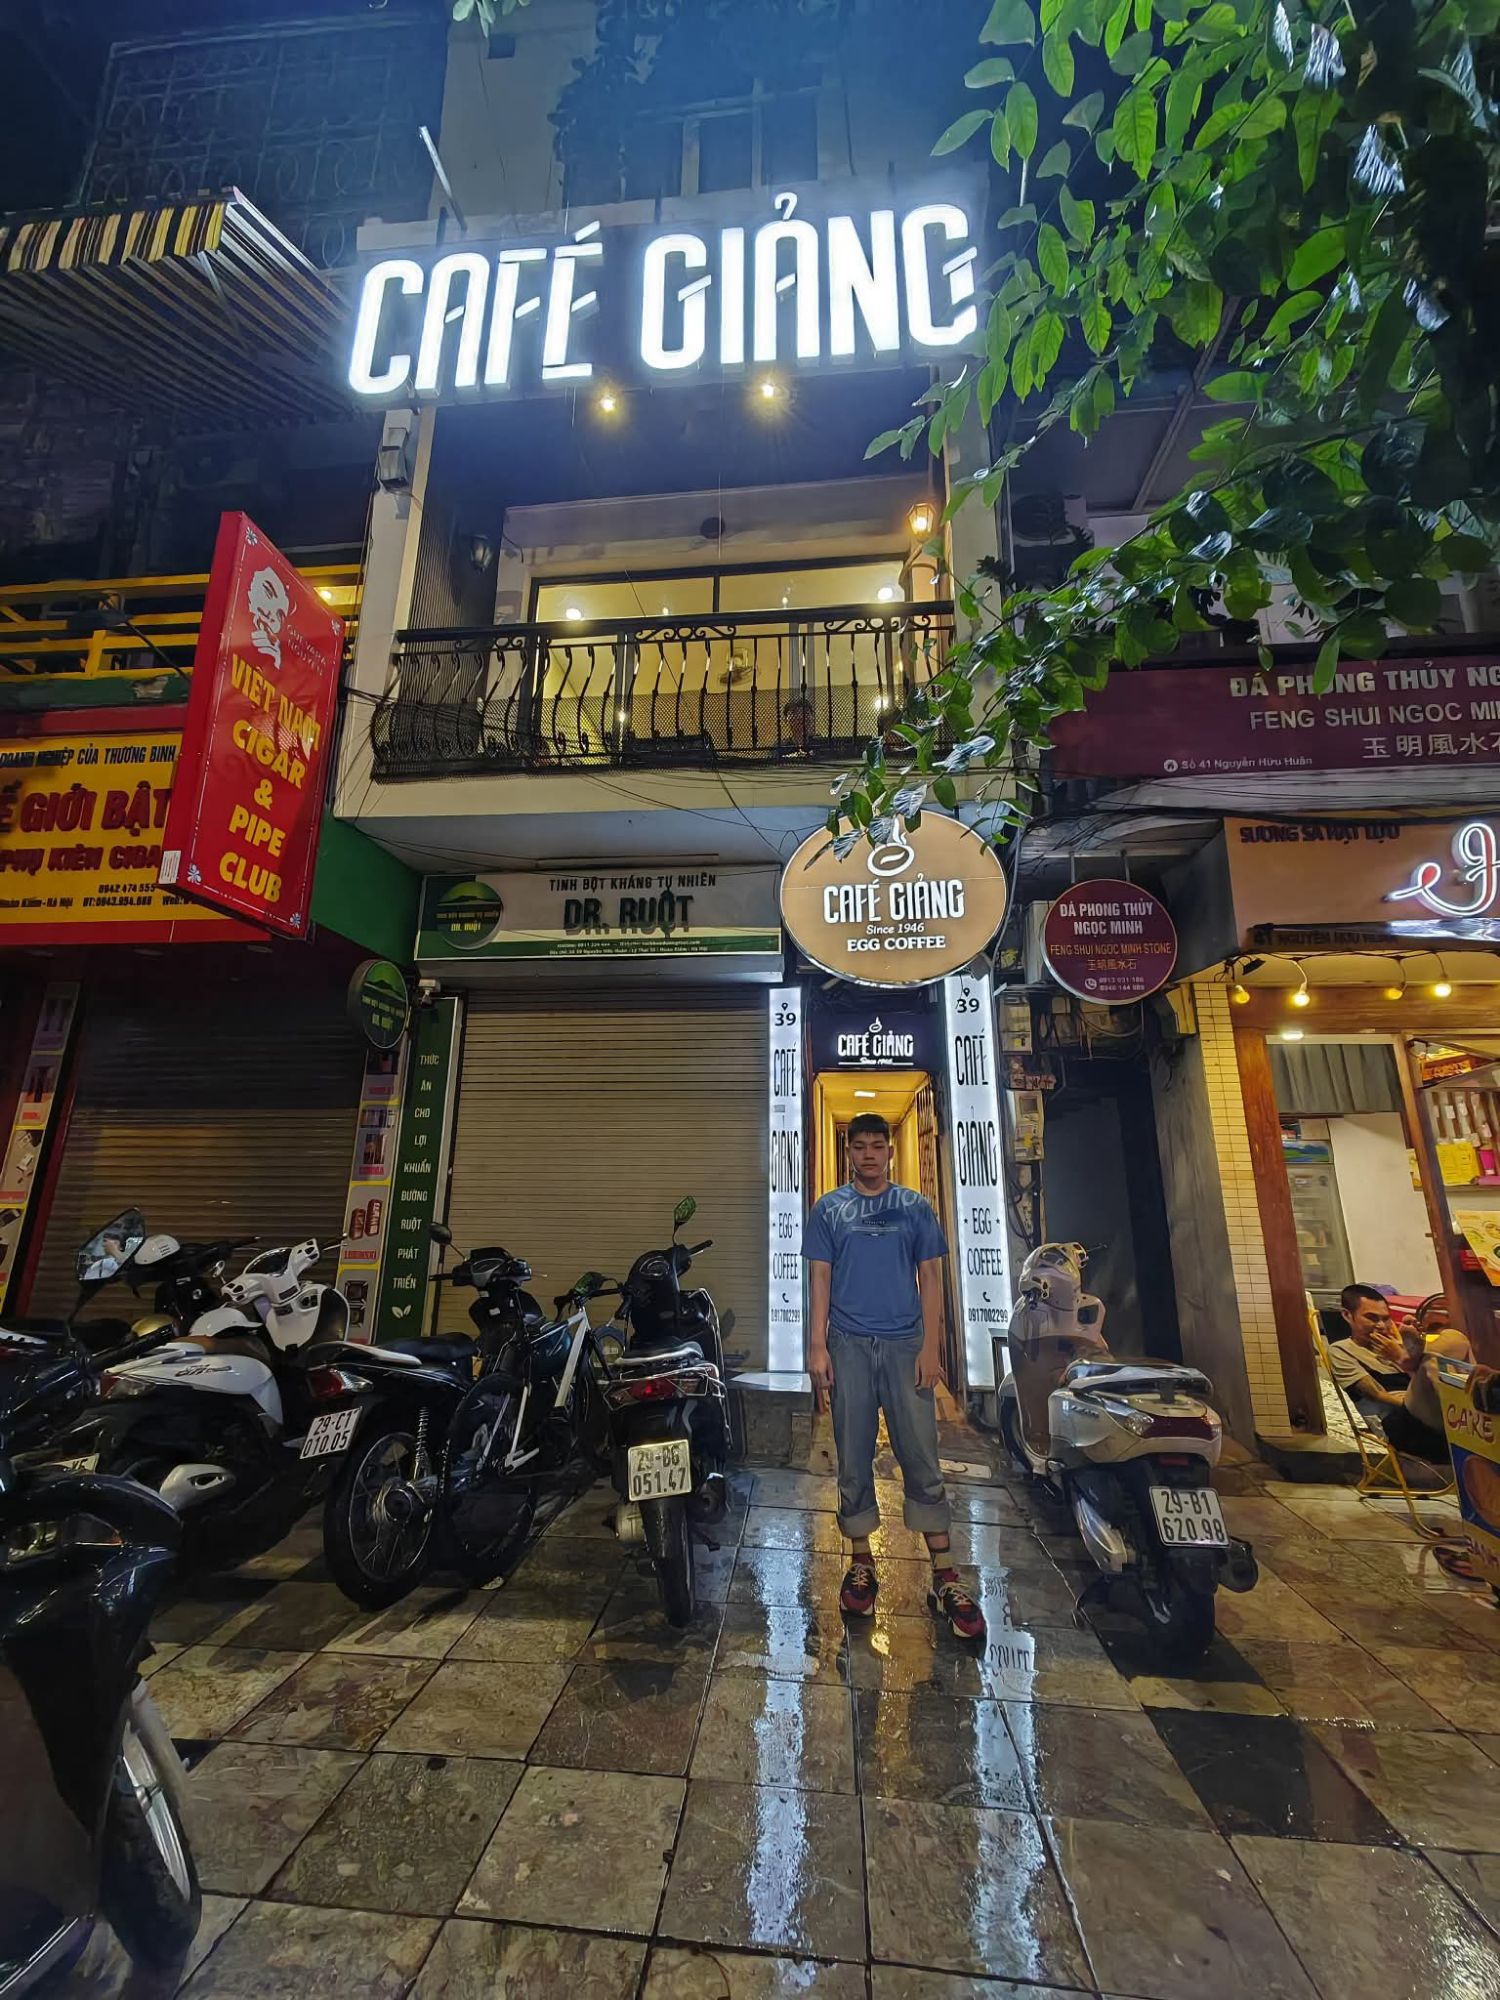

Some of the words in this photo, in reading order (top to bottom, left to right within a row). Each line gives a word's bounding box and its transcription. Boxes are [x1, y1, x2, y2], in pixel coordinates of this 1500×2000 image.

[347, 221, 603, 395] CAFÉ
[640, 192, 977, 370] GIẢNG
[1230, 672, 1269, 697] ĐÁ
[1277, 671, 1376, 697] PHNG
[1383, 661, 1456, 690] THỦY
[277, 693, 321, 751] NAM
[1250, 709, 1315, 730] FENG
[1325, 706, 1381, 727] SHUI
[1389, 703, 1463, 724] NGOC
[150, 745, 176, 763] BINH
[232, 719, 306, 789] CIGAR
[1199, 760, 1211, 769] 41
[254, 778, 273, 811] &
[228, 804, 286, 858] PIPE
[219, 851, 282, 903] CLUB
[550, 879, 577, 891] TINH
[583, 876, 605, 893] BỘT
[610, 875, 652, 890] KHÁNG
[678, 872, 716, 887] NHIÊN
[823, 879, 881, 923] CAFÉ
[889, 873, 965, 921] GIẢNG
[1079, 902, 1120, 917] PHONG
[1123, 897, 1153, 916] THỦY
[564, 898, 610, 935] DR.
[619, 889, 695, 939] RUỘT
[866, 924, 894, 935] Since
[898, 923, 925, 933] 1946
[1074, 921, 1106, 938] NGỌC
[1110, 920, 1143, 935] MINH
[848, 939, 880, 952] EGG
[884, 935, 946, 951] COFFEE
[1050, 944, 1073, 956] FENG
[1074, 944, 1094, 955] SHUI
[1095, 944, 1119, 955] NGOC
[1121, 943, 1142, 954] MINH
[1144, 943, 1172, 954] STONE
[957, 998, 980, 1013] 39
[774, 1013, 796, 1026] 39
[838, 1031, 870, 1057] CAFÉ
[873, 1030, 914, 1057] GIẢNG
[955, 1028, 989, 1085] CAFÉ
[774, 1042, 797, 1096] CAFÉ
[414, 1107, 430, 1118] CHO
[957, 1105, 997, 1186] GIẢNG
[778, 1213, 792, 1238] EGG
[972, 1207, 992, 1234] EGG
[398, 1245, 419, 1260] PHÁT
[773, 1253, 798, 1279] COFFEE
[967, 1248, 1003, 1276] COFFEE
[968, 1308, 1008, 1322] 0917002299
[313, 1411, 353, 1436] 29-C1
[1447, 1403, 1496, 1444] CAKE
[303, 1430, 351, 1457] 010.05
[633, 1467, 686, 1496] 051.47
[1161, 1491, 1212, 1516] 29-B1
[1162, 1517, 1225, 1542] 620.98
